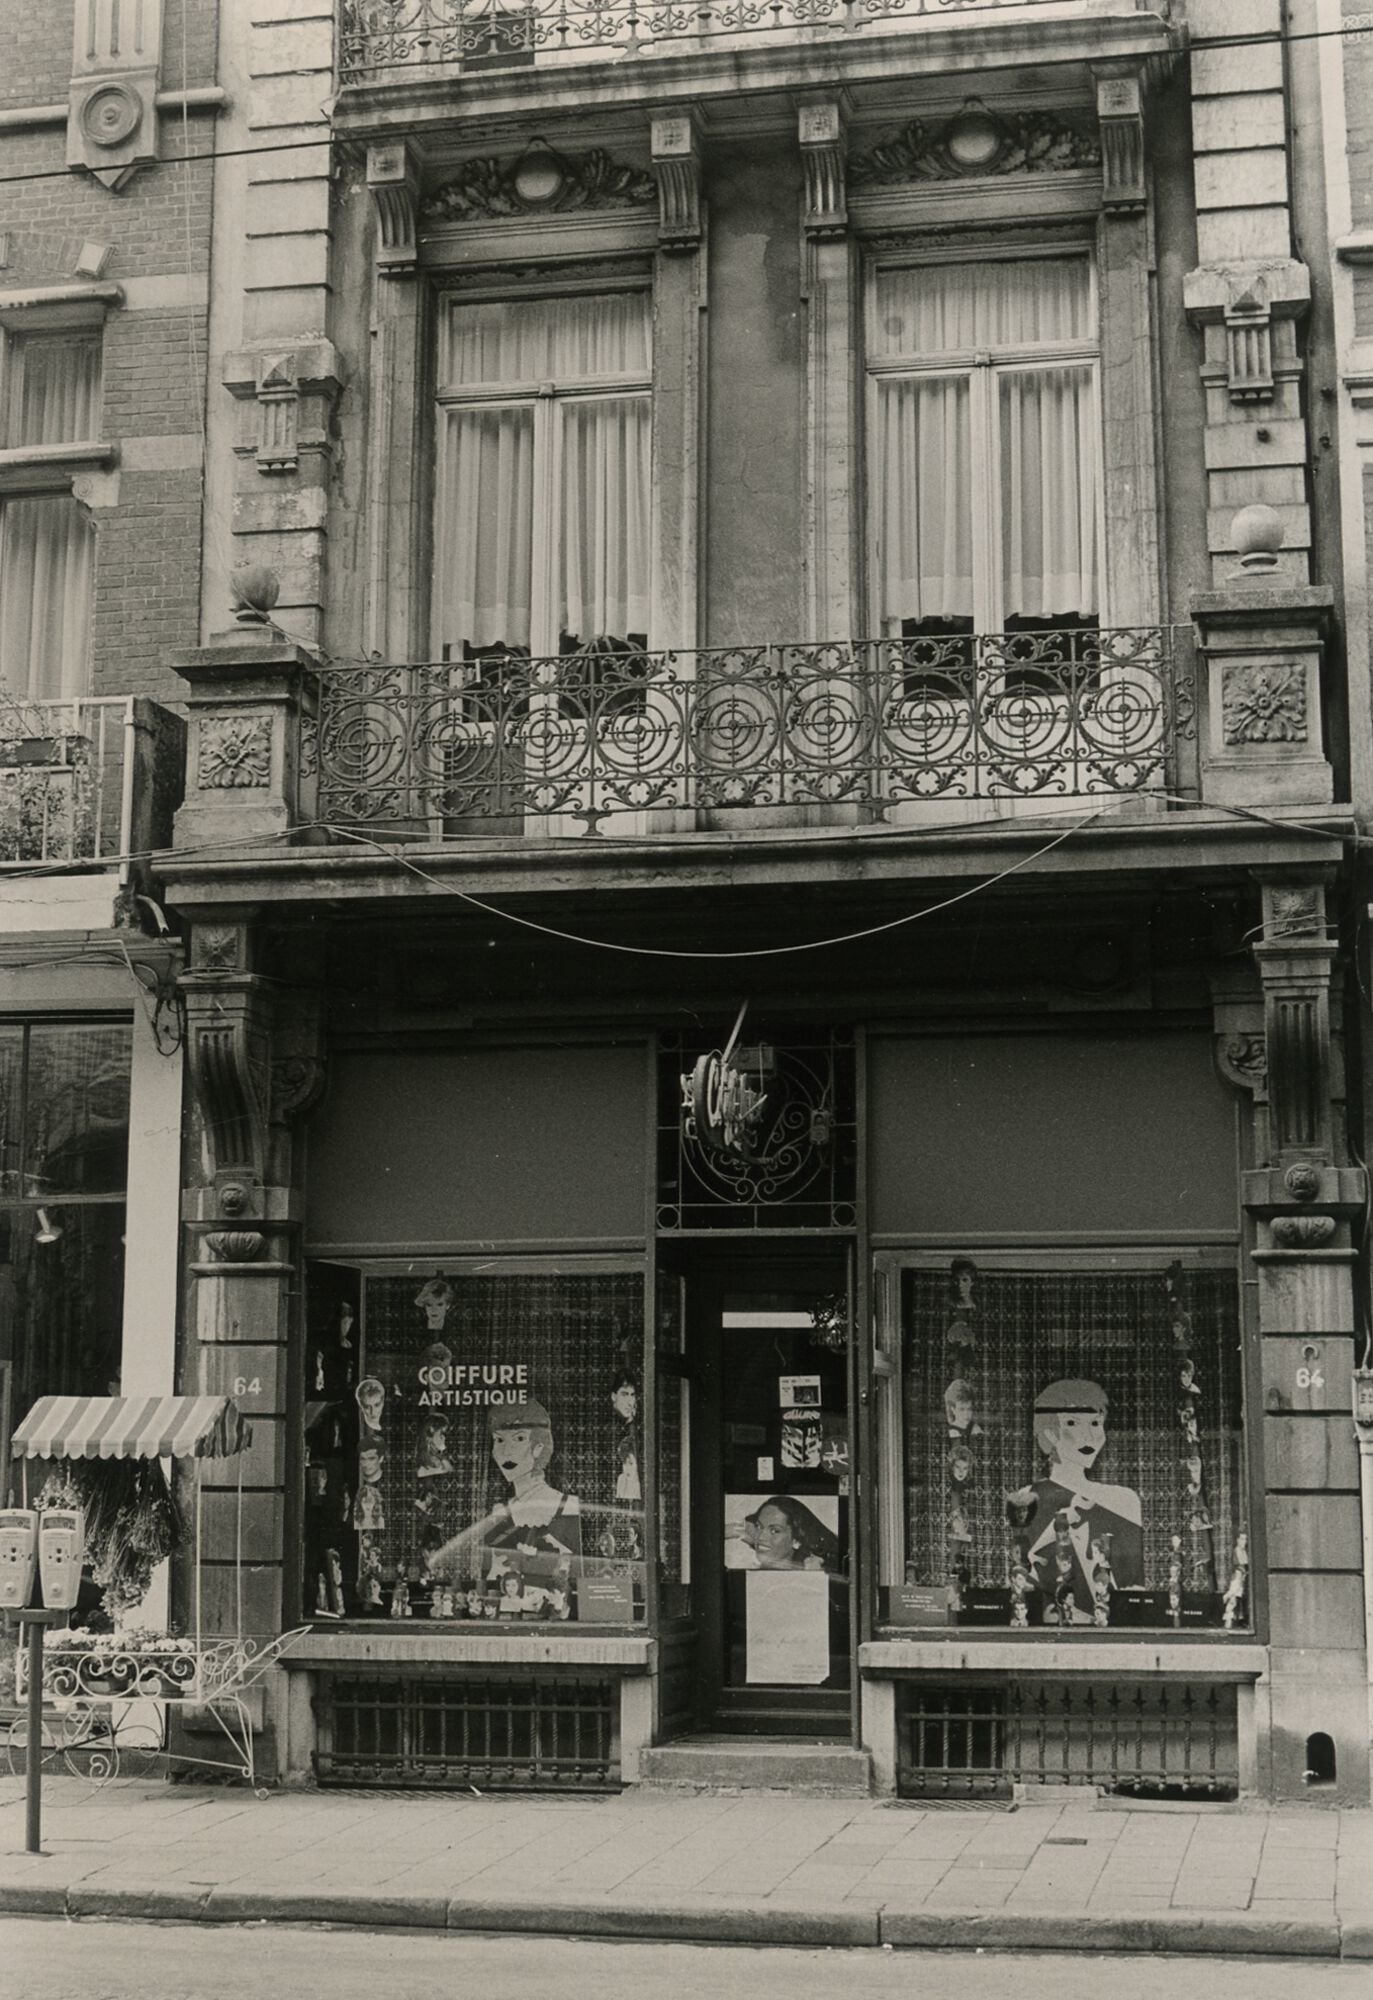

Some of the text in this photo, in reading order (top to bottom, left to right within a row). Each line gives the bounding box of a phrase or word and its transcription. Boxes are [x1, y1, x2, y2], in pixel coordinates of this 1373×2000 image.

[418, 1365, 528, 1385] COIFFURE
[1296, 1367, 1325, 1388] 64
[234, 1376, 262, 1396] 64
[418, 1390, 528, 1406] ARTISTIQUE
